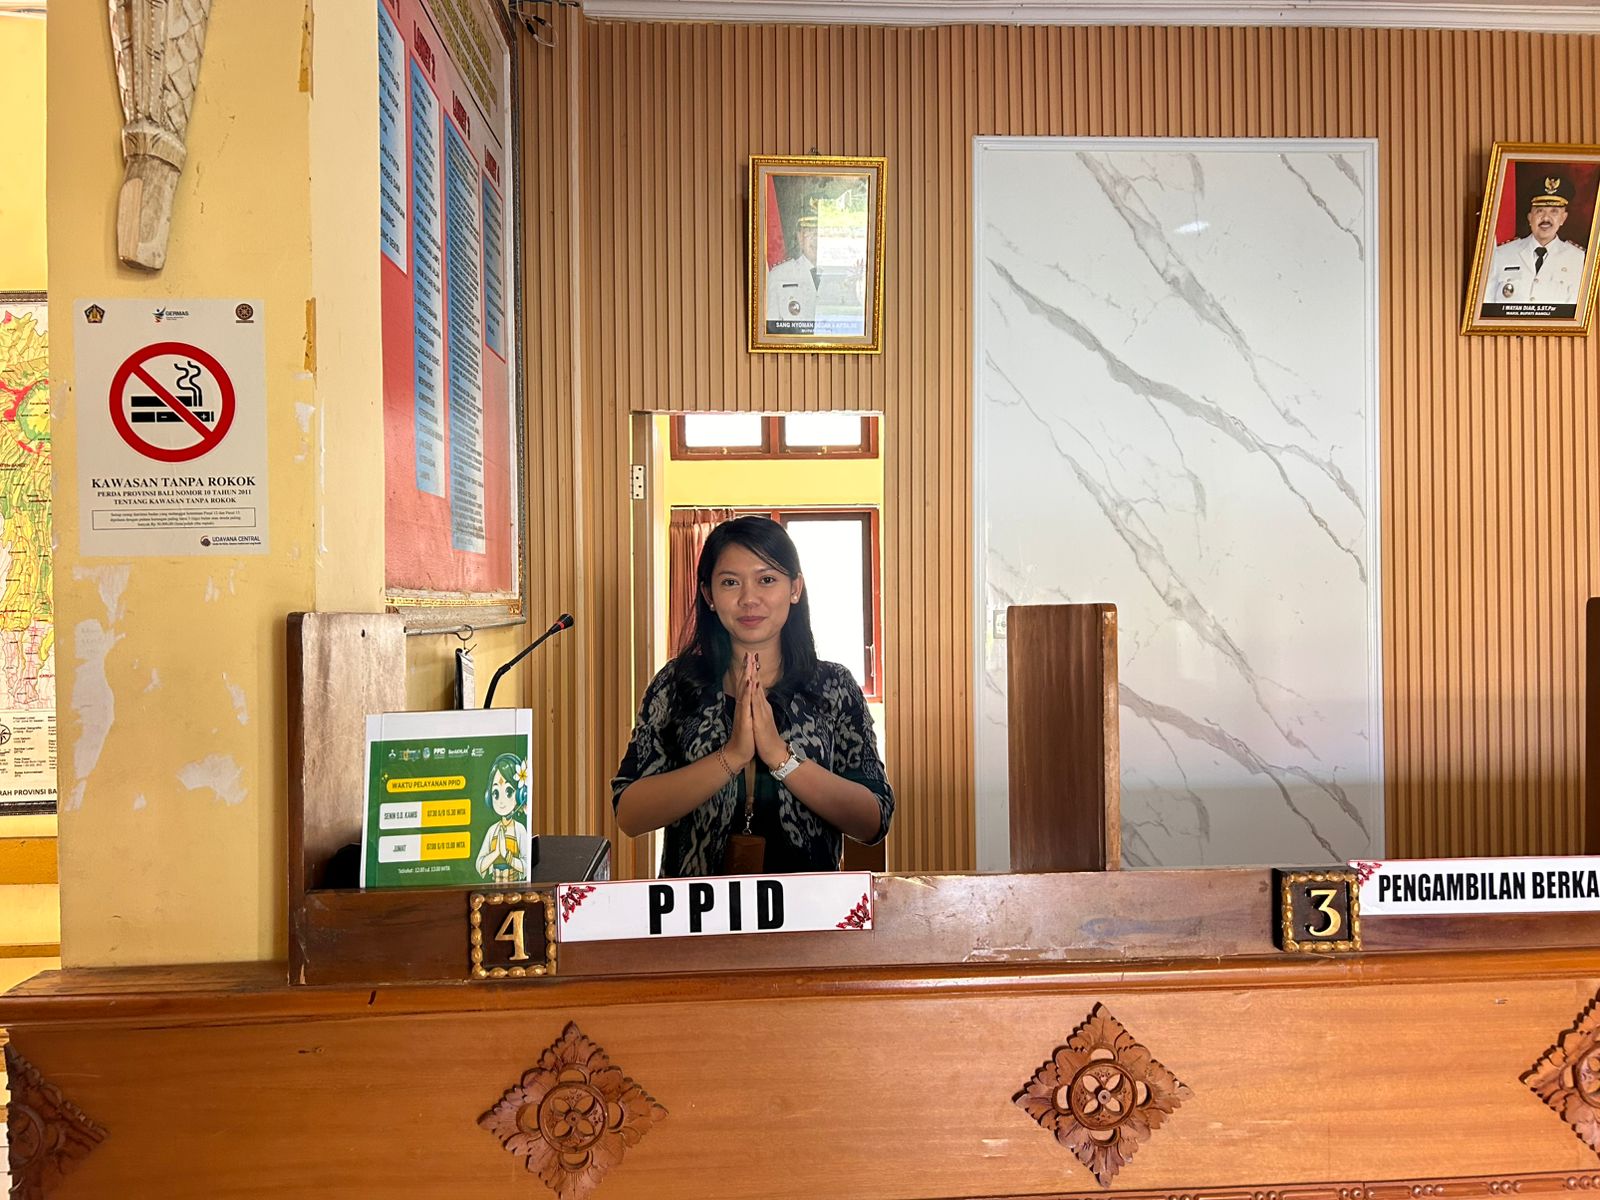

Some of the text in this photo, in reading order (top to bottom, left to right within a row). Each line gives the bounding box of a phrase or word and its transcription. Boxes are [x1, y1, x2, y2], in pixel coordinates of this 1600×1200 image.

[92, 476, 256, 488] KAWASAN TANPA ROKOK
[392, 781, 412, 789] WAKTU
[413, 780, 447, 788] PELAYANAN
[1378, 870, 1600, 902] PENGAMBILAN BERKA
[648, 880, 785, 935] PPID
[1309, 889, 1342, 936] 3
[495, 910, 530, 962] 4
